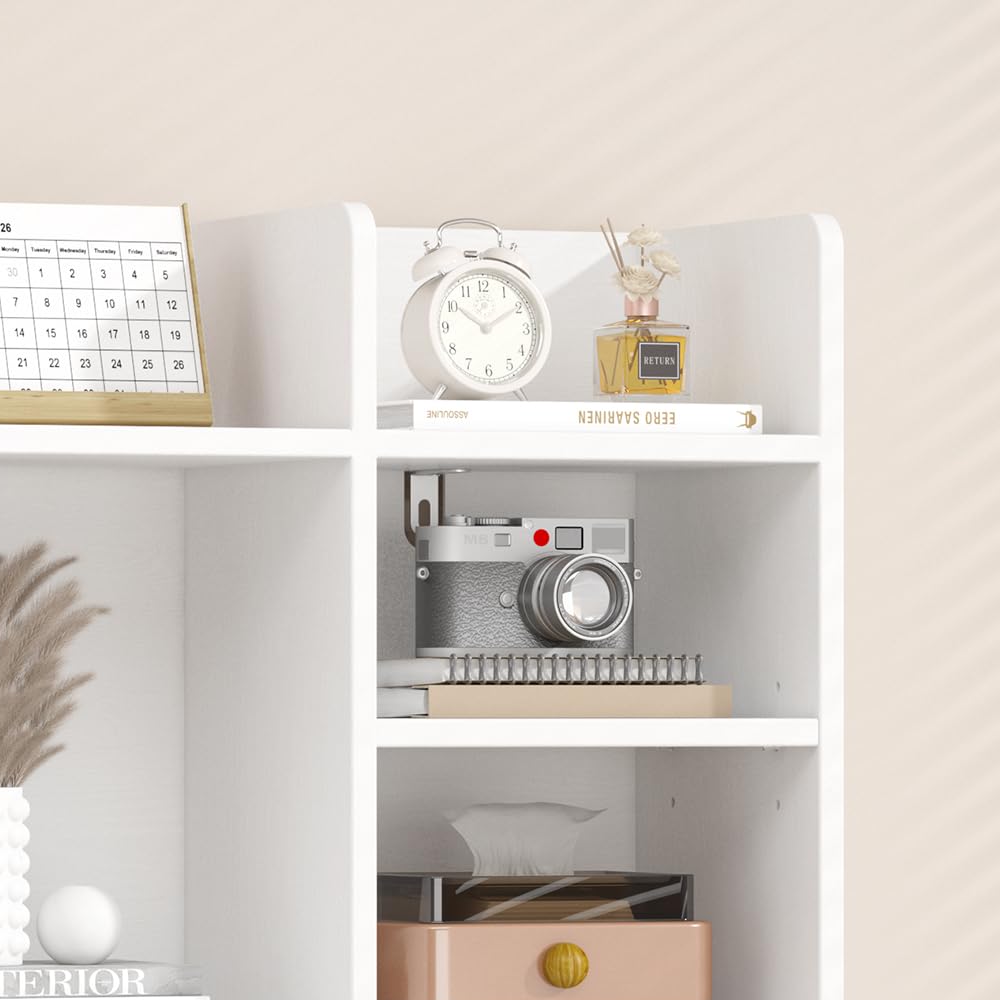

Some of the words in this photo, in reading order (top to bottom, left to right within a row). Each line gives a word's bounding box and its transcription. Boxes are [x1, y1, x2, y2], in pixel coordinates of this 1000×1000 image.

[39, 269, 43, 277] 1
[70, 269, 75, 278] 2
[101, 269, 106, 278] 3
[132, 270, 137, 278] 4
[163, 270, 168, 280] 5
[462, 286, 470, 297] 11
[478, 280, 488, 292] 12
[502, 287, 505, 298] 1
[13, 297, 18, 306] 7
[44, 298, 50, 307] 8
[76, 299, 81, 308] 9
[105, 299, 115, 308] 10
[136, 300, 145, 308] 11
[167, 300, 177, 310] 12
[448, 301, 458, 312] 10
[516, 302, 522, 313] 2
[442, 322, 449, 333] 9
[523, 323, 530, 335] 3
[15, 328, 24, 336] 14
[46, 328, 56, 338] 15
[78, 329, 87, 338] 16
[109, 329, 118, 338] 17
[140, 330, 150, 339] 18
[171, 331, 180, 340] 19
[449, 343, 456, 355] 8
[519, 345, 524, 356] 4
[17, 358, 27, 367] 21
[49, 358, 59, 367] 22
[80, 359, 91, 368] 23
[112, 359, 122, 368] 24
[143, 359, 153, 369] 25
[174, 360, 184, 369] 26
[465, 358, 472, 370] 7
[506, 359, 513, 370] 5
[644, 356, 675, 365] RETURN
[485, 365, 493, 377] 6
[427, 410, 468, 419] ASSOULINE
[578, 410, 640, 424] SAARINEN
[645, 411, 675, 424] EERO
